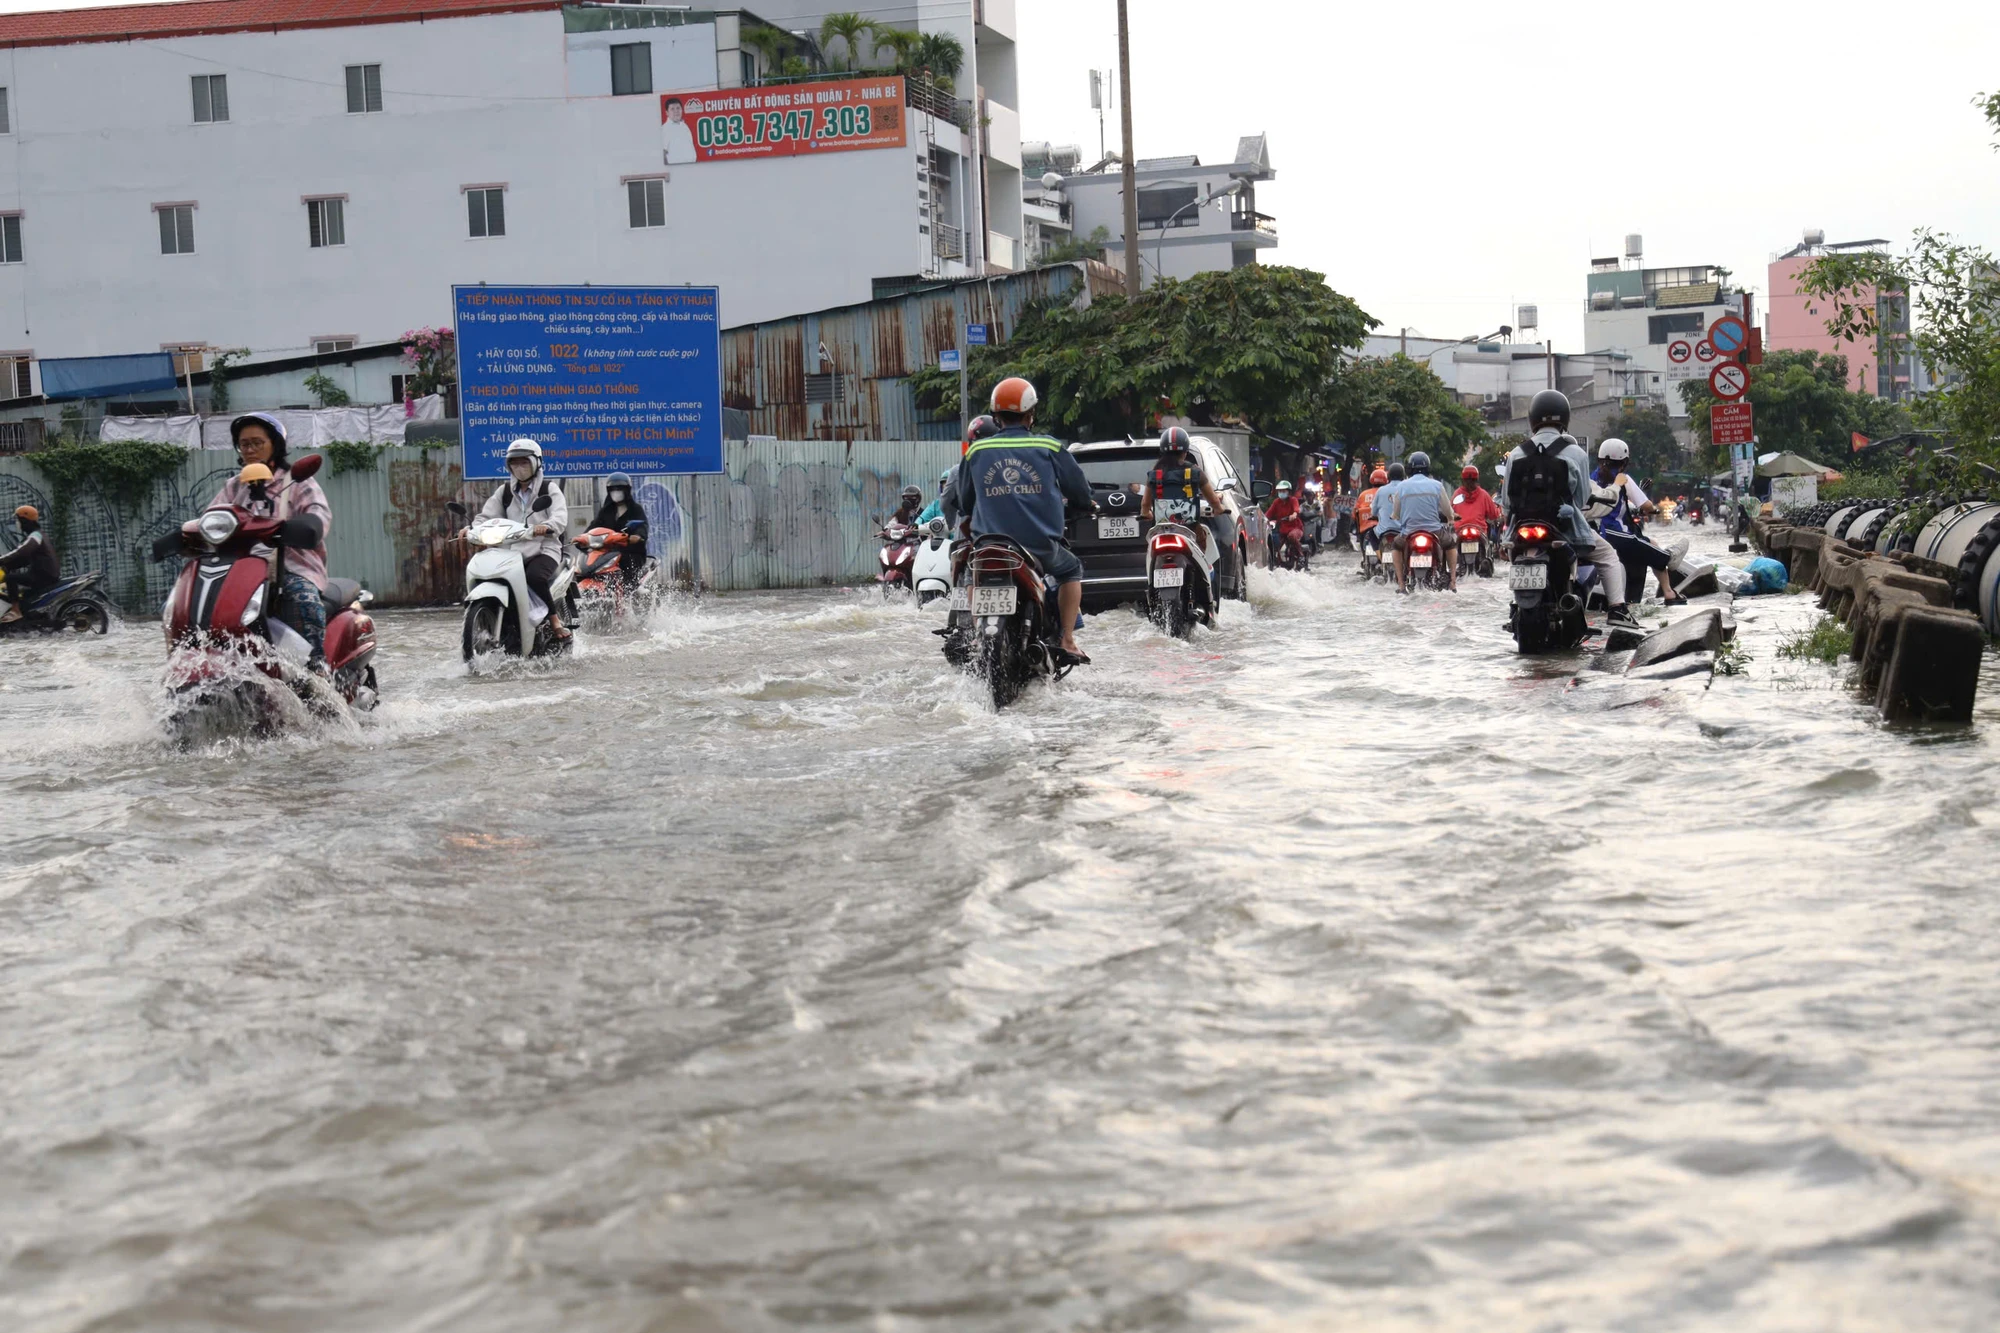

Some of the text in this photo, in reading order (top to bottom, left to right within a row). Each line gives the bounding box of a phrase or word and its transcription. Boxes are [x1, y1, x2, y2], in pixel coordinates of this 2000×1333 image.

[705, 97, 740, 112] CHUYÊN
[744, 94, 762, 108] BẤT
[765, 94, 790, 109] ĐỘNG
[794, 90, 813, 104] SẢN
[816, 89, 842, 104] QUẬN
[846, 90, 851, 100] 7
[862, 85, 882, 99] NHÀ
[697, 104, 871, 147] 093.7347.303
[466, 292, 489, 305] TIẾP
[492, 294, 523, 306] NHẬN
[526, 294, 561, 305] THÔNG
[565, 295, 581, 305] TIN
[585, 295, 599, 306] SỰ
[602, 292, 615, 305] CỐ
[635, 293, 663, 305] TẦNG
[460, 312, 475, 323] (Hạ
[477, 311, 496, 323] tầng
[499, 313, 517, 322] giao
[549, 313, 567, 322] giao
[569, 312, 593, 322] thông
[595, 312, 614, 322] công
[642, 311, 656, 322] cấp
[658, 312, 668, 320] và
[670, 312, 690, 320] thoát
[544, 324, 568, 333] chiếu
[595, 325, 610, 335] cây
[486, 348, 504, 358] HÃY
[507, 349, 522, 359] GỌI
[525, 346, 540, 358] SỐ:
[550, 344, 579, 357] 1022
[584, 349, 615, 359] (không
[636, 348, 657, 357] cước
[660, 348, 679, 358] cuộc
[681, 348, 699, 359] gọi)
[487, 362, 502, 373] TẢI
[504, 362, 524, 373] ỨNG
[527, 364, 556, 375] DỤNG:
[470, 386, 498, 396] THEO
[522, 384, 546, 394] TÌNH
[549, 383, 574, 394] HÌNH
[578, 385, 602, 394] GIAO
[605, 383, 639, 394] THÔNG
[465, 402, 484, 412] (Bản
[488, 402, 498, 412] đồ
[500, 402, 516, 411] tình
[519, 402, 542, 412] trạng
[544, 402, 562, 412] giao
[564, 402, 588, 412] thông
[590, 401, 609, 410] theo
[611, 401, 626, 409] thời
[629, 401, 646, 411] gian
[1724, 406, 1739, 415] CẤM
[469, 417, 488, 426] giao
[520, 416, 540, 425] phản
[561, 416, 571, 425] sự
[574, 414, 584, 423] cố
[586, 415, 596, 425] hạ
[598, 414, 617, 424] tầng
[619, 414, 629, 422] và
[631, 414, 645, 422] các
[646, 414, 661, 423] tiện
[678, 413, 701, 422] khác)
[490, 431, 505, 442] TẢI
[565, 428, 602, 441] "TTGT
[606, 428, 622, 440] TP
[625, 428, 641, 439] Hồ
[666, 427, 700, 439] Minh"
[548, 462, 564, 472] XÂY
[567, 462, 591, 472] DỰNG
[593, 462, 605, 470] TP.
[607, 459, 618, 469] HỒ
[620, 460, 634, 469] CHÍ
[994, 461, 1003, 469] TY
[1004, 459, 1022, 467] TNHH
[985, 485, 1011, 497] LONG
[1110, 519, 1127, 527] 60K
[1104, 528, 1135, 537] 352.95
[1515, 566, 1540, 577] 59-L2
[1511, 578, 1544, 588] 729.63
[980, 589, 1010, 600] 59-F2
[976, 601, 1012, 614] 296.55
